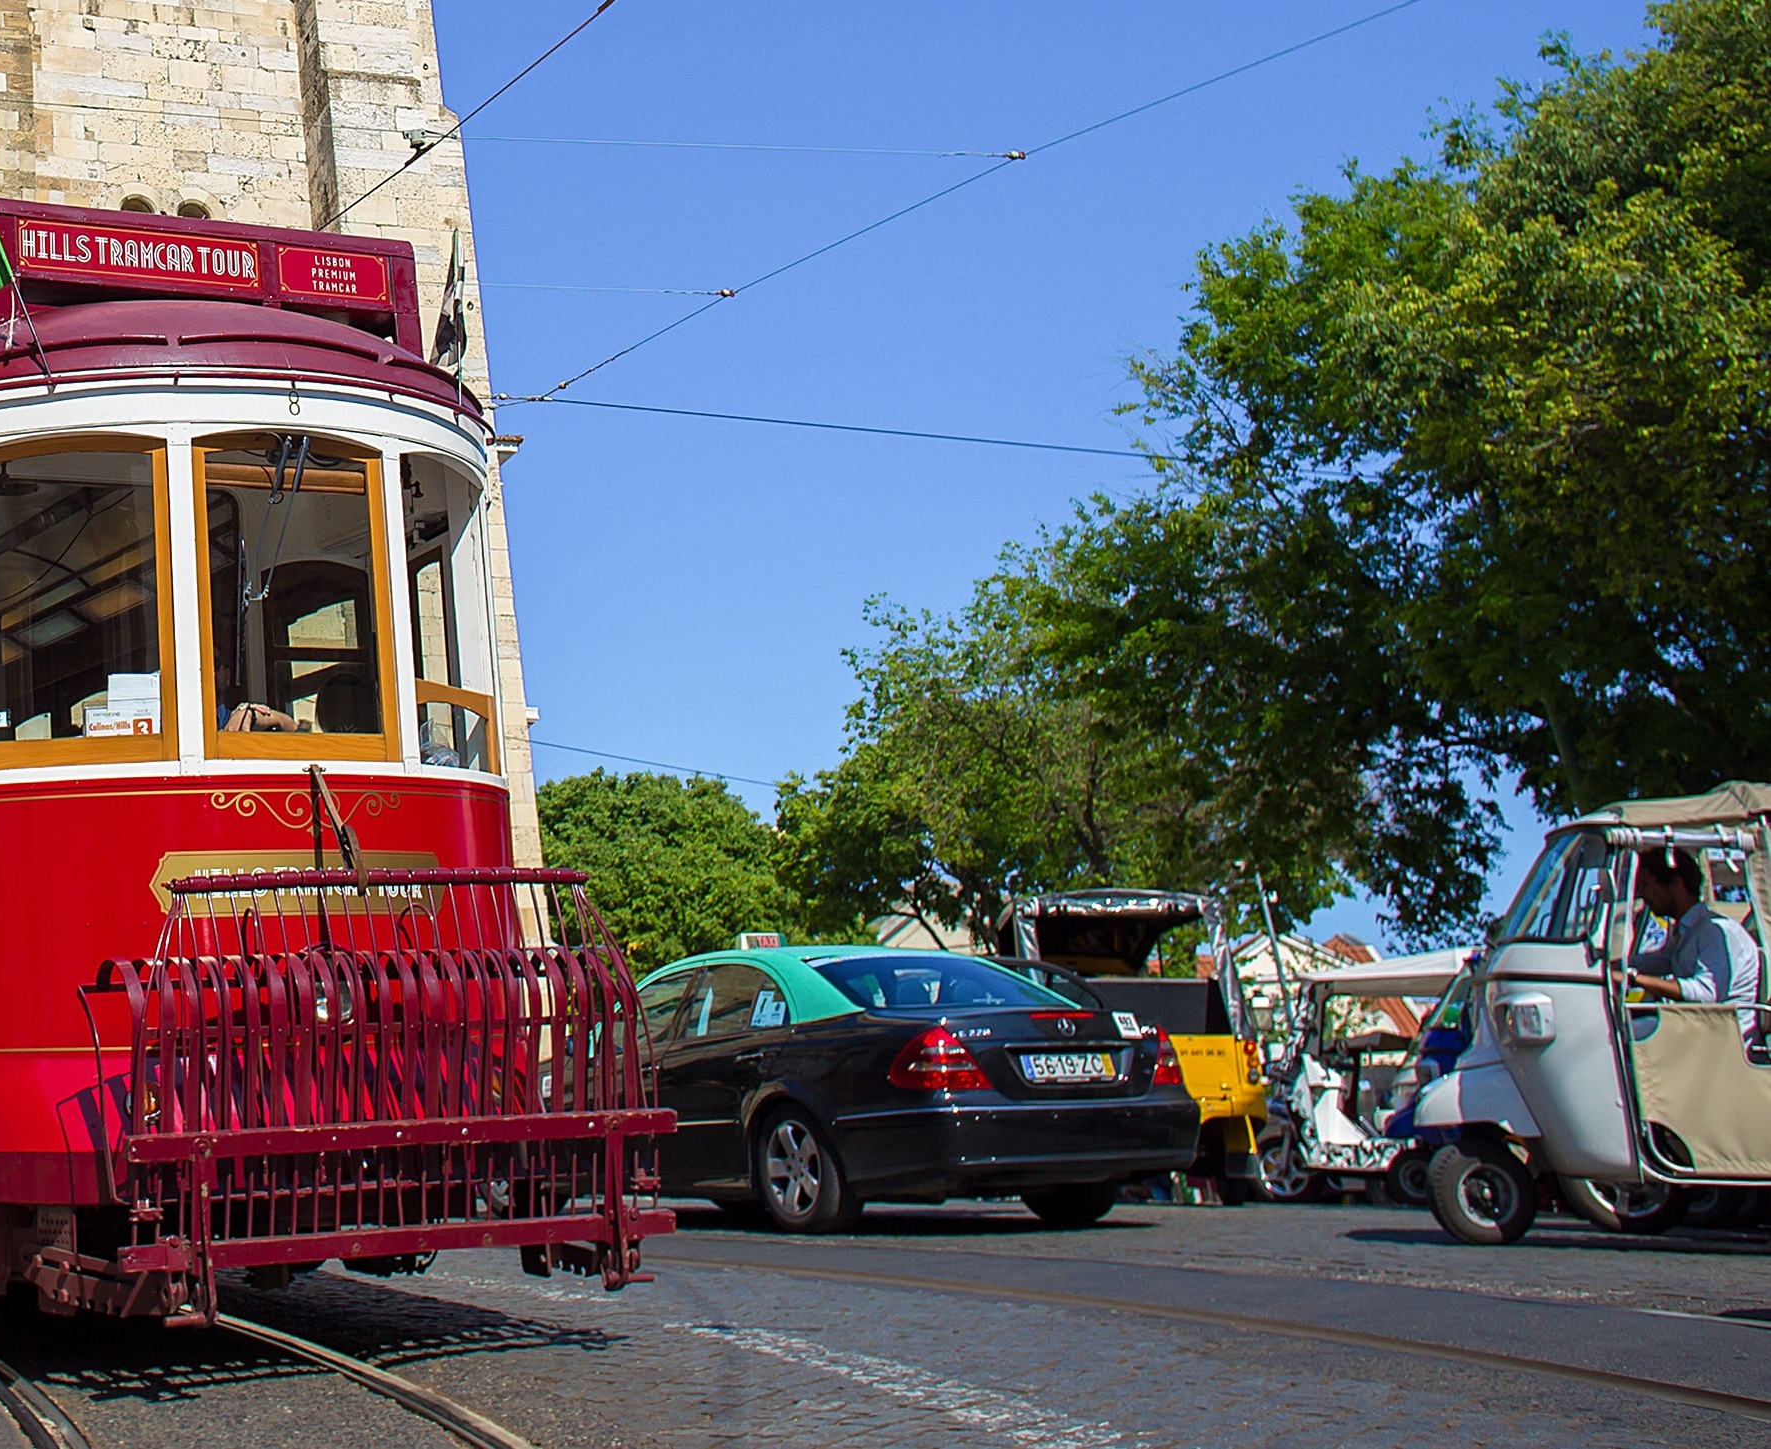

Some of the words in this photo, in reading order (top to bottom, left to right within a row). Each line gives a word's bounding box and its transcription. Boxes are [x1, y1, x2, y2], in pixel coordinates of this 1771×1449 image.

[21, 229, 91, 263] HILLS
[95, 236, 195, 273] TRAMCAR
[197, 246, 256, 279] TOUR
[314, 255, 351, 268] LISBON
[311, 267, 356, 281] PREMIUM
[312, 280, 357, 294] TRAMCAR
[289, 391, 300, 415] 8
[137, 721, 150, 735] 3
[757, 935, 779, 948] TAXI
